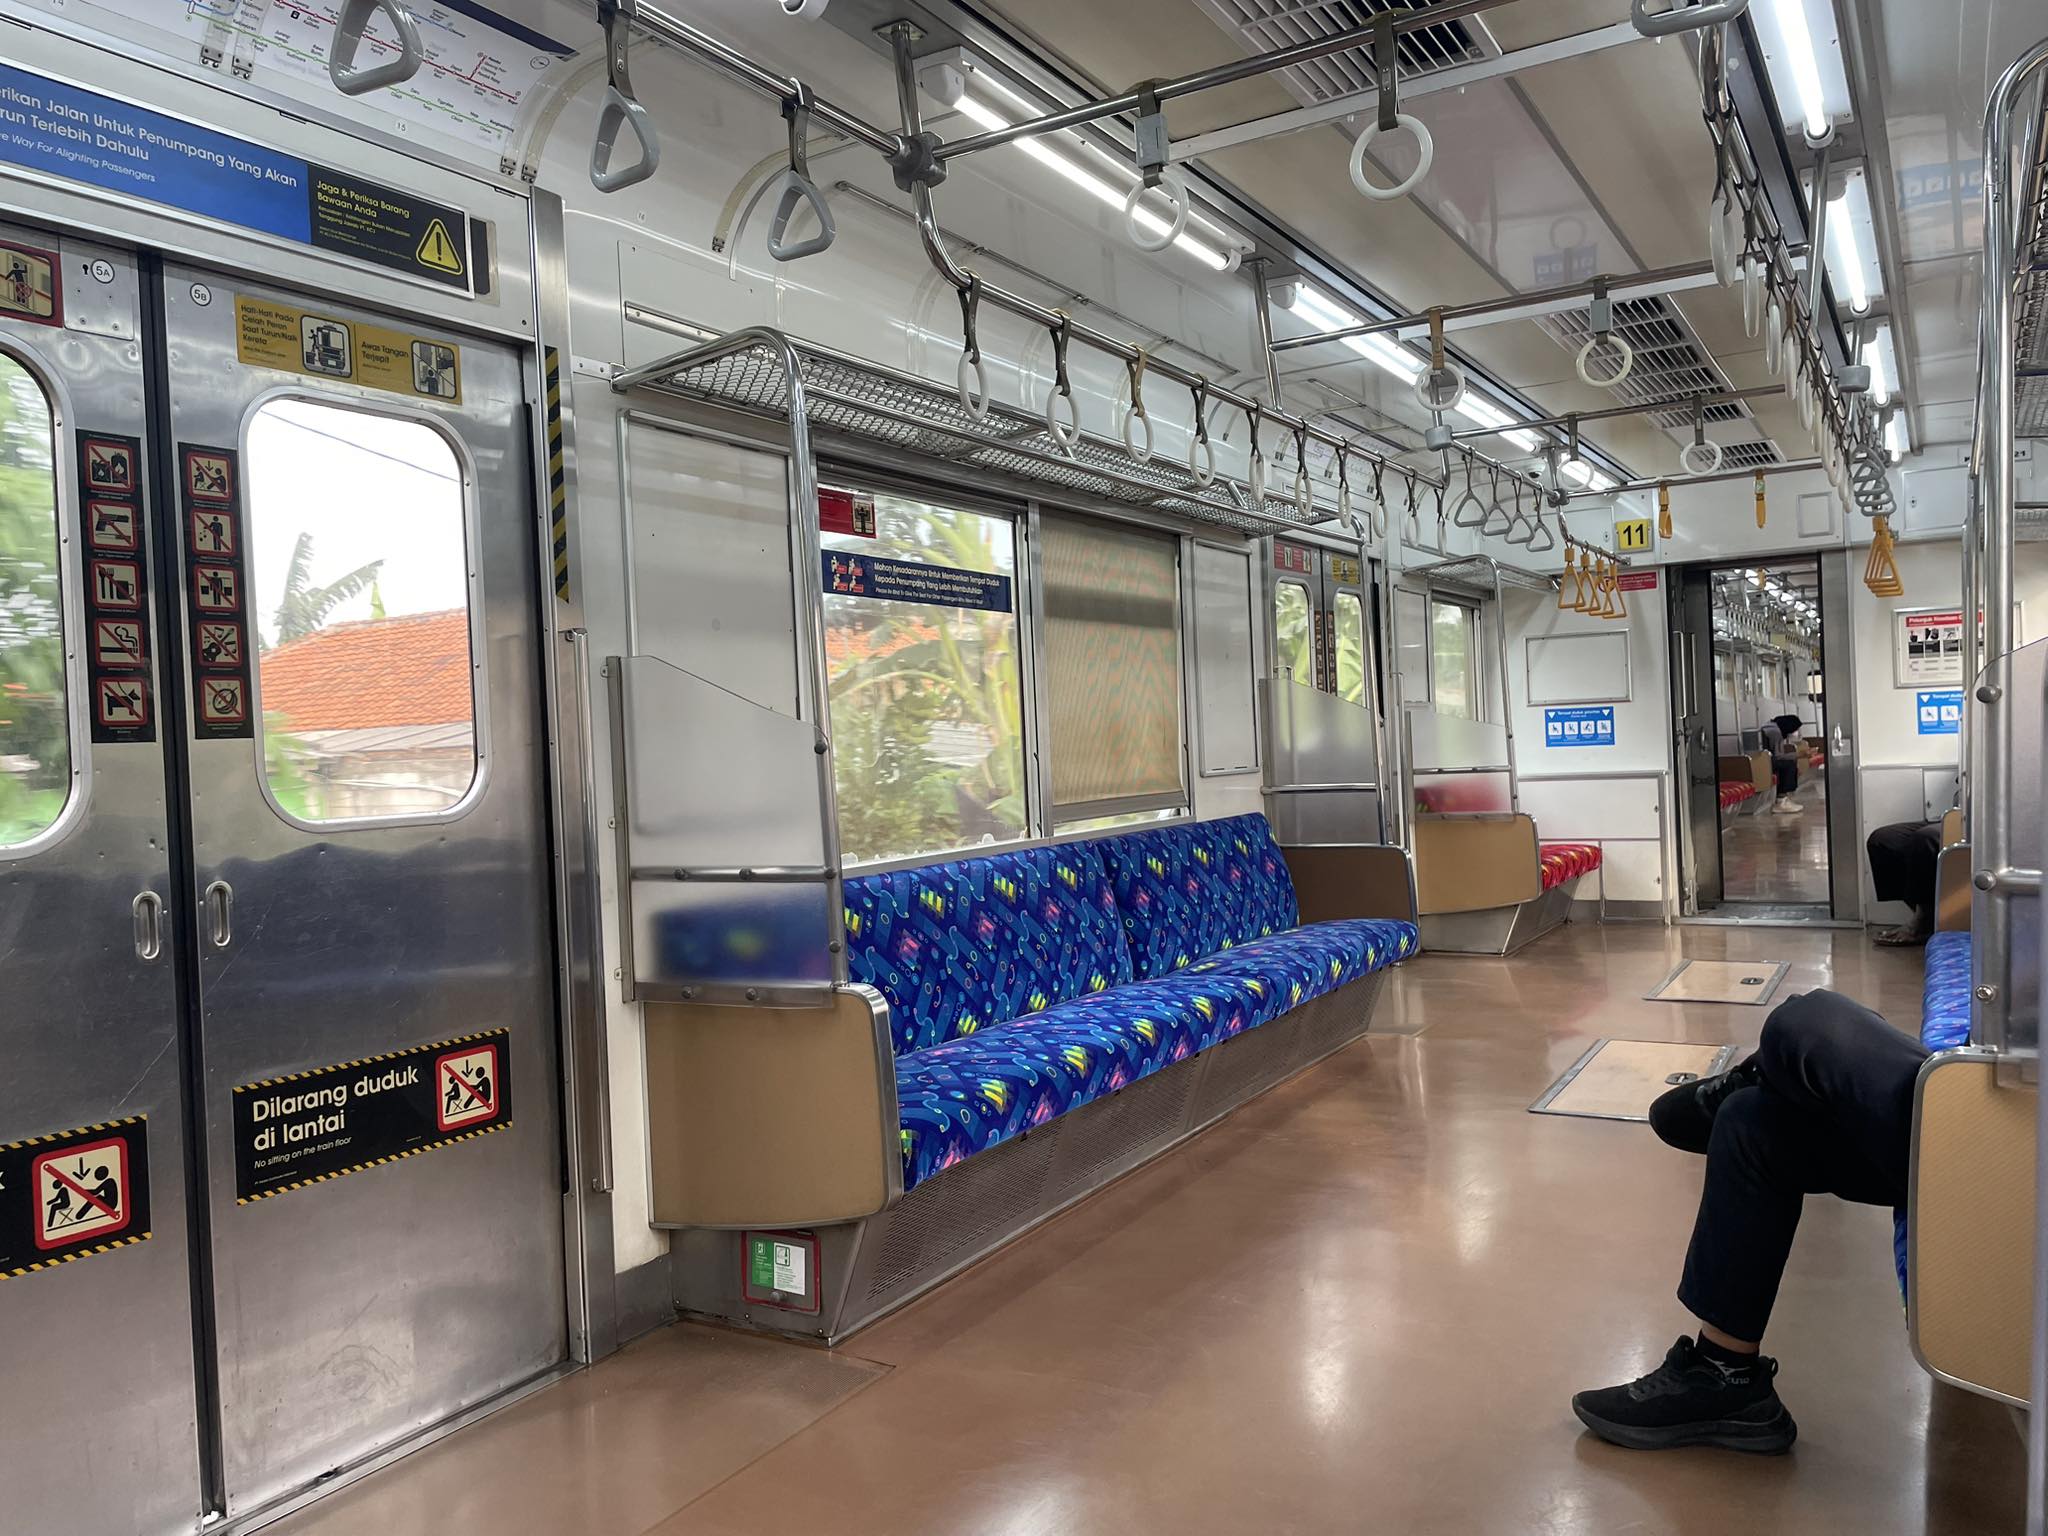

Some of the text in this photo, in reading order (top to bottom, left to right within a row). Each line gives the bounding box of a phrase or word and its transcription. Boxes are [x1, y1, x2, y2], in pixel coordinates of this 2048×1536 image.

[30, 114, 91, 144] Terlebih
[96, 134, 149, 160] Dahulu
[46, 100, 89, 123] Jalan
[93, 113, 135, 137] Untuk
[139, 127, 225, 167] Penumpang
[228, 155, 262, 179] Yang
[265, 167, 297, 187] Akan
[12, 134, 35, 150] Way
[37, 141, 54, 154] For
[55, 147, 99, 168] Alighting
[101, 159, 156, 182] Passengers
[317, 180, 410, 219] Jaga & Periksa Barang
[317, 192, 377, 218] Bawaan Anda
[96, 265, 110, 277] 5A
[194, 289, 207, 301] 5B
[242, 313, 265, 325] Celah
[243, 333, 267, 345] Kereta
[361, 341, 409, 358] Awas Tangan
[1623, 523, 1644, 546] 11
[874, 574, 896, 585] Kepada
[253, 1065, 418, 1122] Dilarang duduk
[253, 1109, 345, 1151] di lantai
[254, 1136, 352, 1170] No sitting on the train floor
